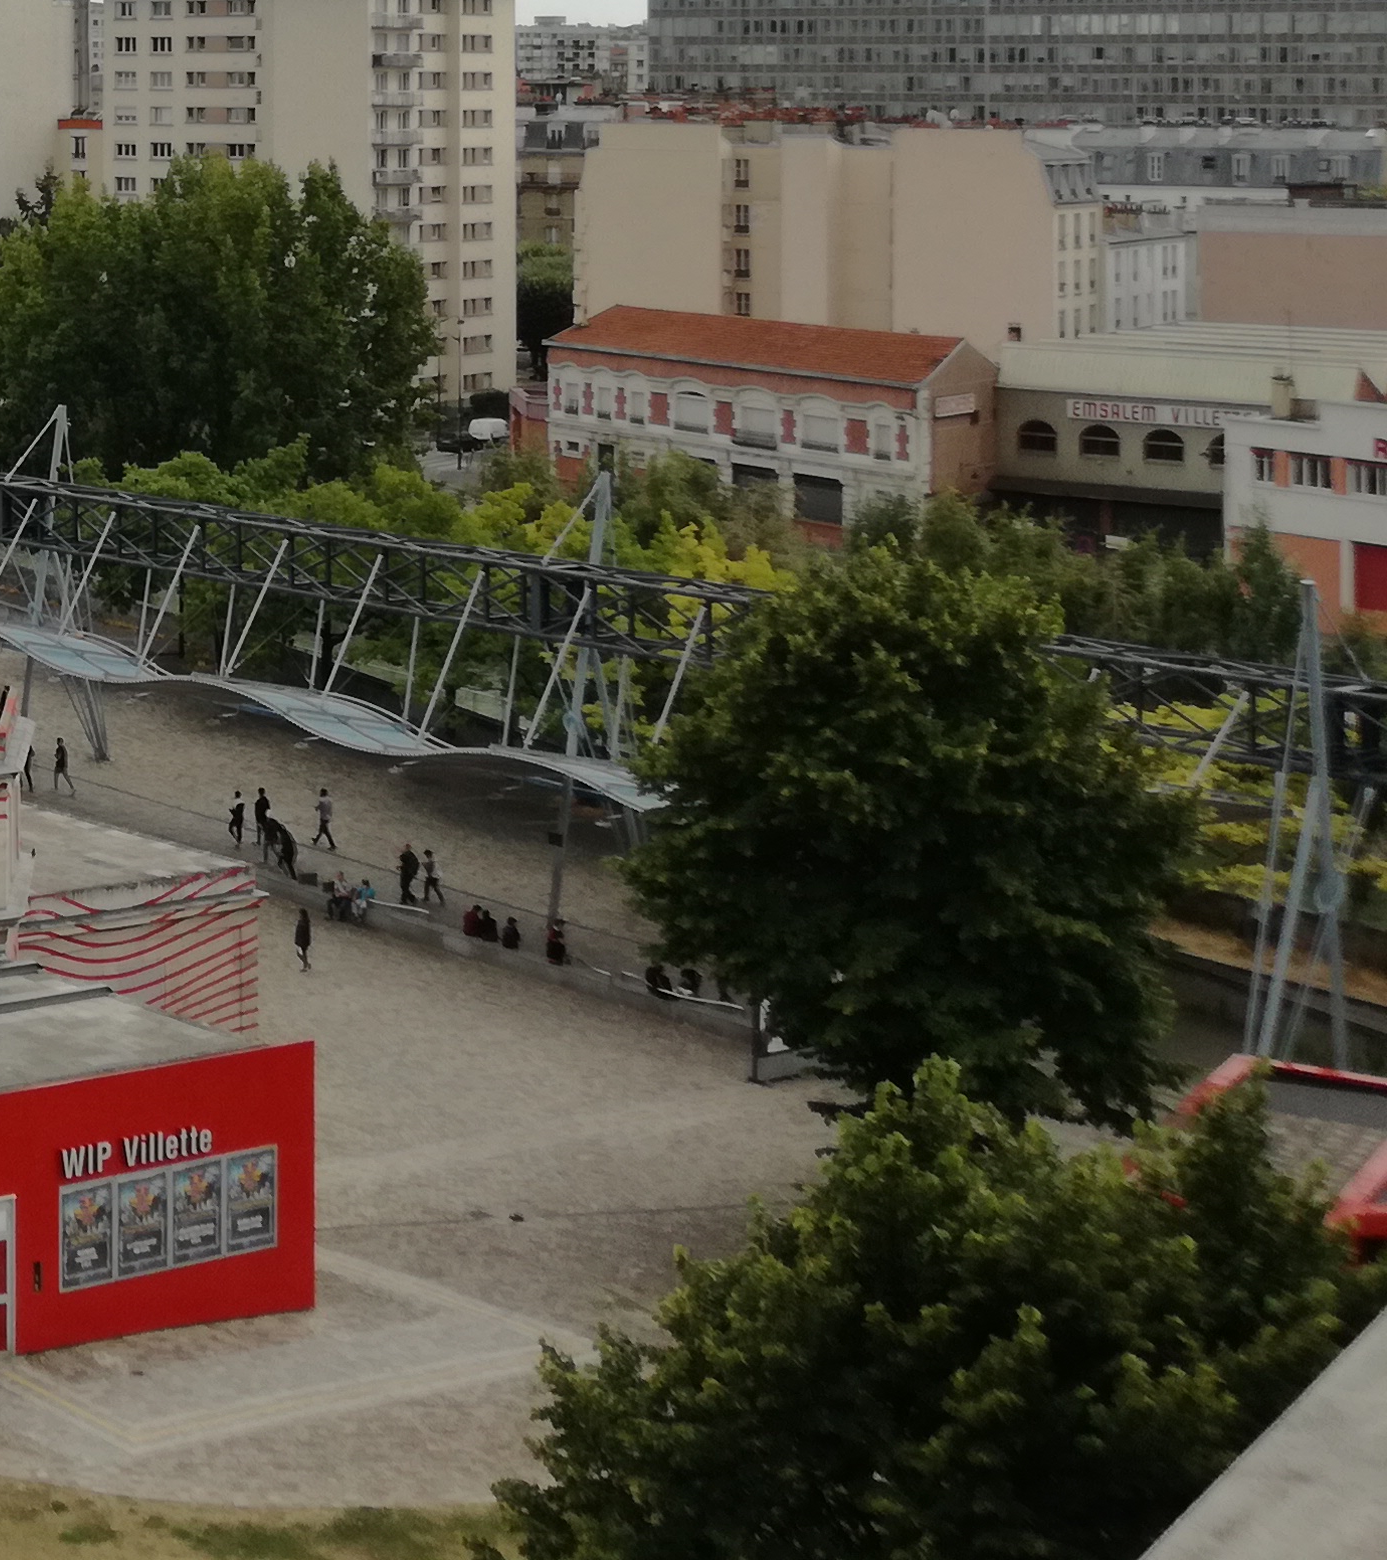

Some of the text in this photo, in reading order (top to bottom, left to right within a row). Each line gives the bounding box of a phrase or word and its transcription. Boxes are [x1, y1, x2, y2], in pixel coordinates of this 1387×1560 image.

[1072, 401, 1252, 426] EMSALEM VILLE
[61, 1125, 212, 1179] WIP Villette
